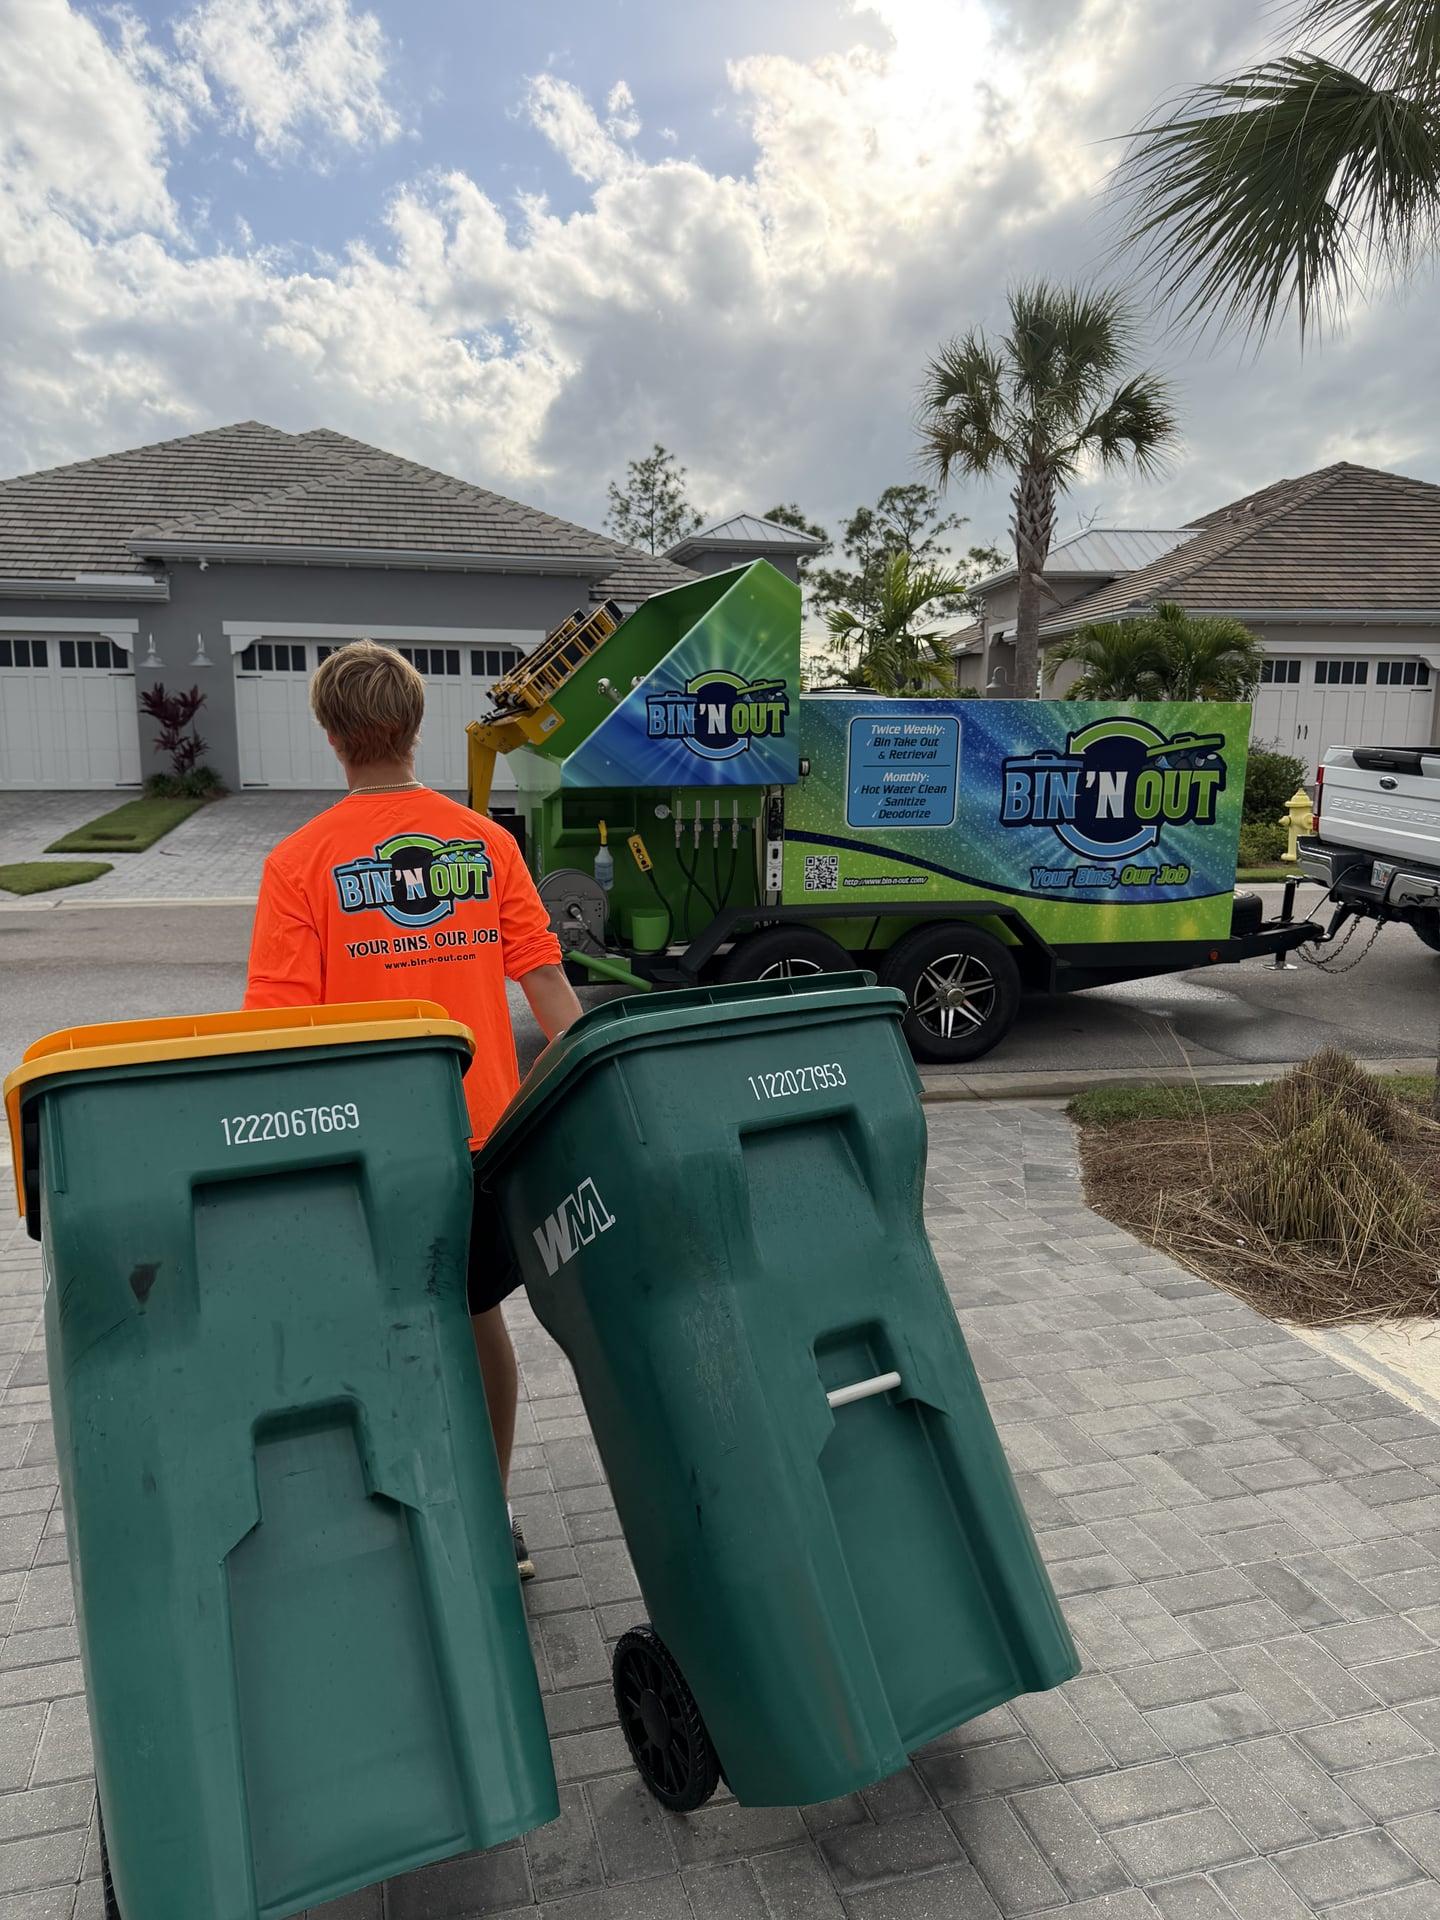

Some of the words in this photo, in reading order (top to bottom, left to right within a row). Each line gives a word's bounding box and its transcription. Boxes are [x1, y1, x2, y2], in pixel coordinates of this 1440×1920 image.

[649, 704, 695, 734] BIN
[732, 703, 785, 734] OUT
[872, 725, 900, 734] Twice
[904, 725, 945, 735] Weekly:
[874, 738, 890, 746] Bin
[894, 737, 917, 746] Take
[920, 737, 939, 746] Out
[878, 751, 885, 759] &
[889, 750, 936, 759] Retrieval
[883, 772, 929, 783] Monthly:
[861, 785, 880, 794] Hot
[883, 785, 914, 793] Water
[918, 785, 947, 793] Clean
[1003, 771, 1079, 820] BIN
[1135, 770, 1220, 819] OUT
[885, 797, 926, 806] Sanitize
[1330, 798, 1393, 816] SUPER
[878, 809, 931, 818] Deodorize
[1032, 868, 1073, 886] Your
[1076, 867, 1117, 887] Bins,
[1121, 867, 1154, 885] Our
[1156, 866, 1189, 885] Job
[338, 870, 394, 908] BIN
[429, 863, 488, 897] OUT
[346, 940, 389, 958] YOUR
[434, 932, 467, 947] OUR
[471, 929, 499, 944] JOB
[384, 953, 476, 969] www.bin-n-out.com
[748, 1063, 847, 1100] 1122027953
[220, 1103, 360, 1146] 1222067669
